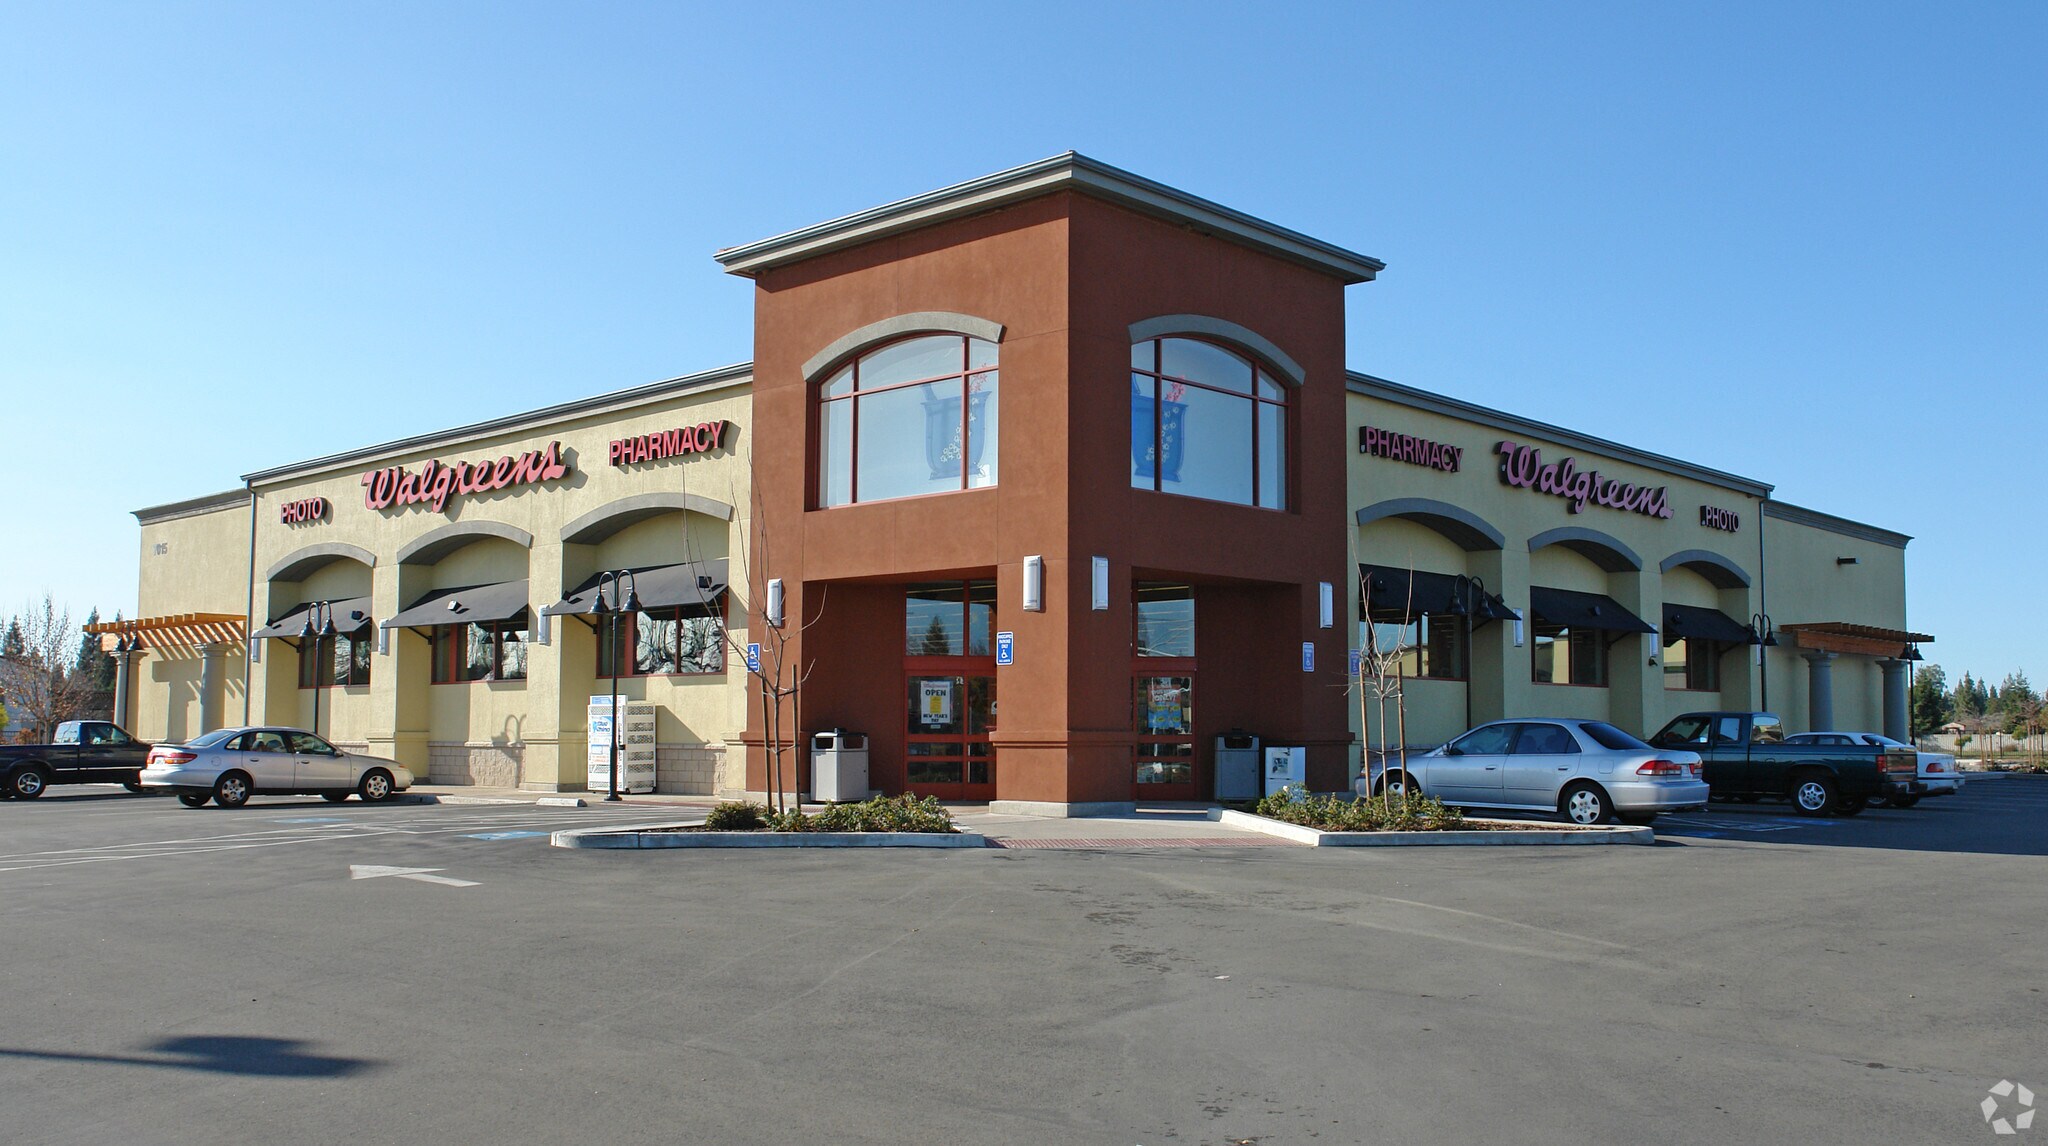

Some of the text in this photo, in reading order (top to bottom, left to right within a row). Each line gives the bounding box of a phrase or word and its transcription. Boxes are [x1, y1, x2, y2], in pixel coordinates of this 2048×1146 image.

[609, 420, 729, 466] PHARMACY
[1361, 426, 1464, 472] PHARMACY
[361, 441, 570, 513] Walgreens
[1496, 440, 1674, 519] Walgreens
[280, 496, 326, 524] PHOTO
[1702, 504, 1741, 532] PHOTO
